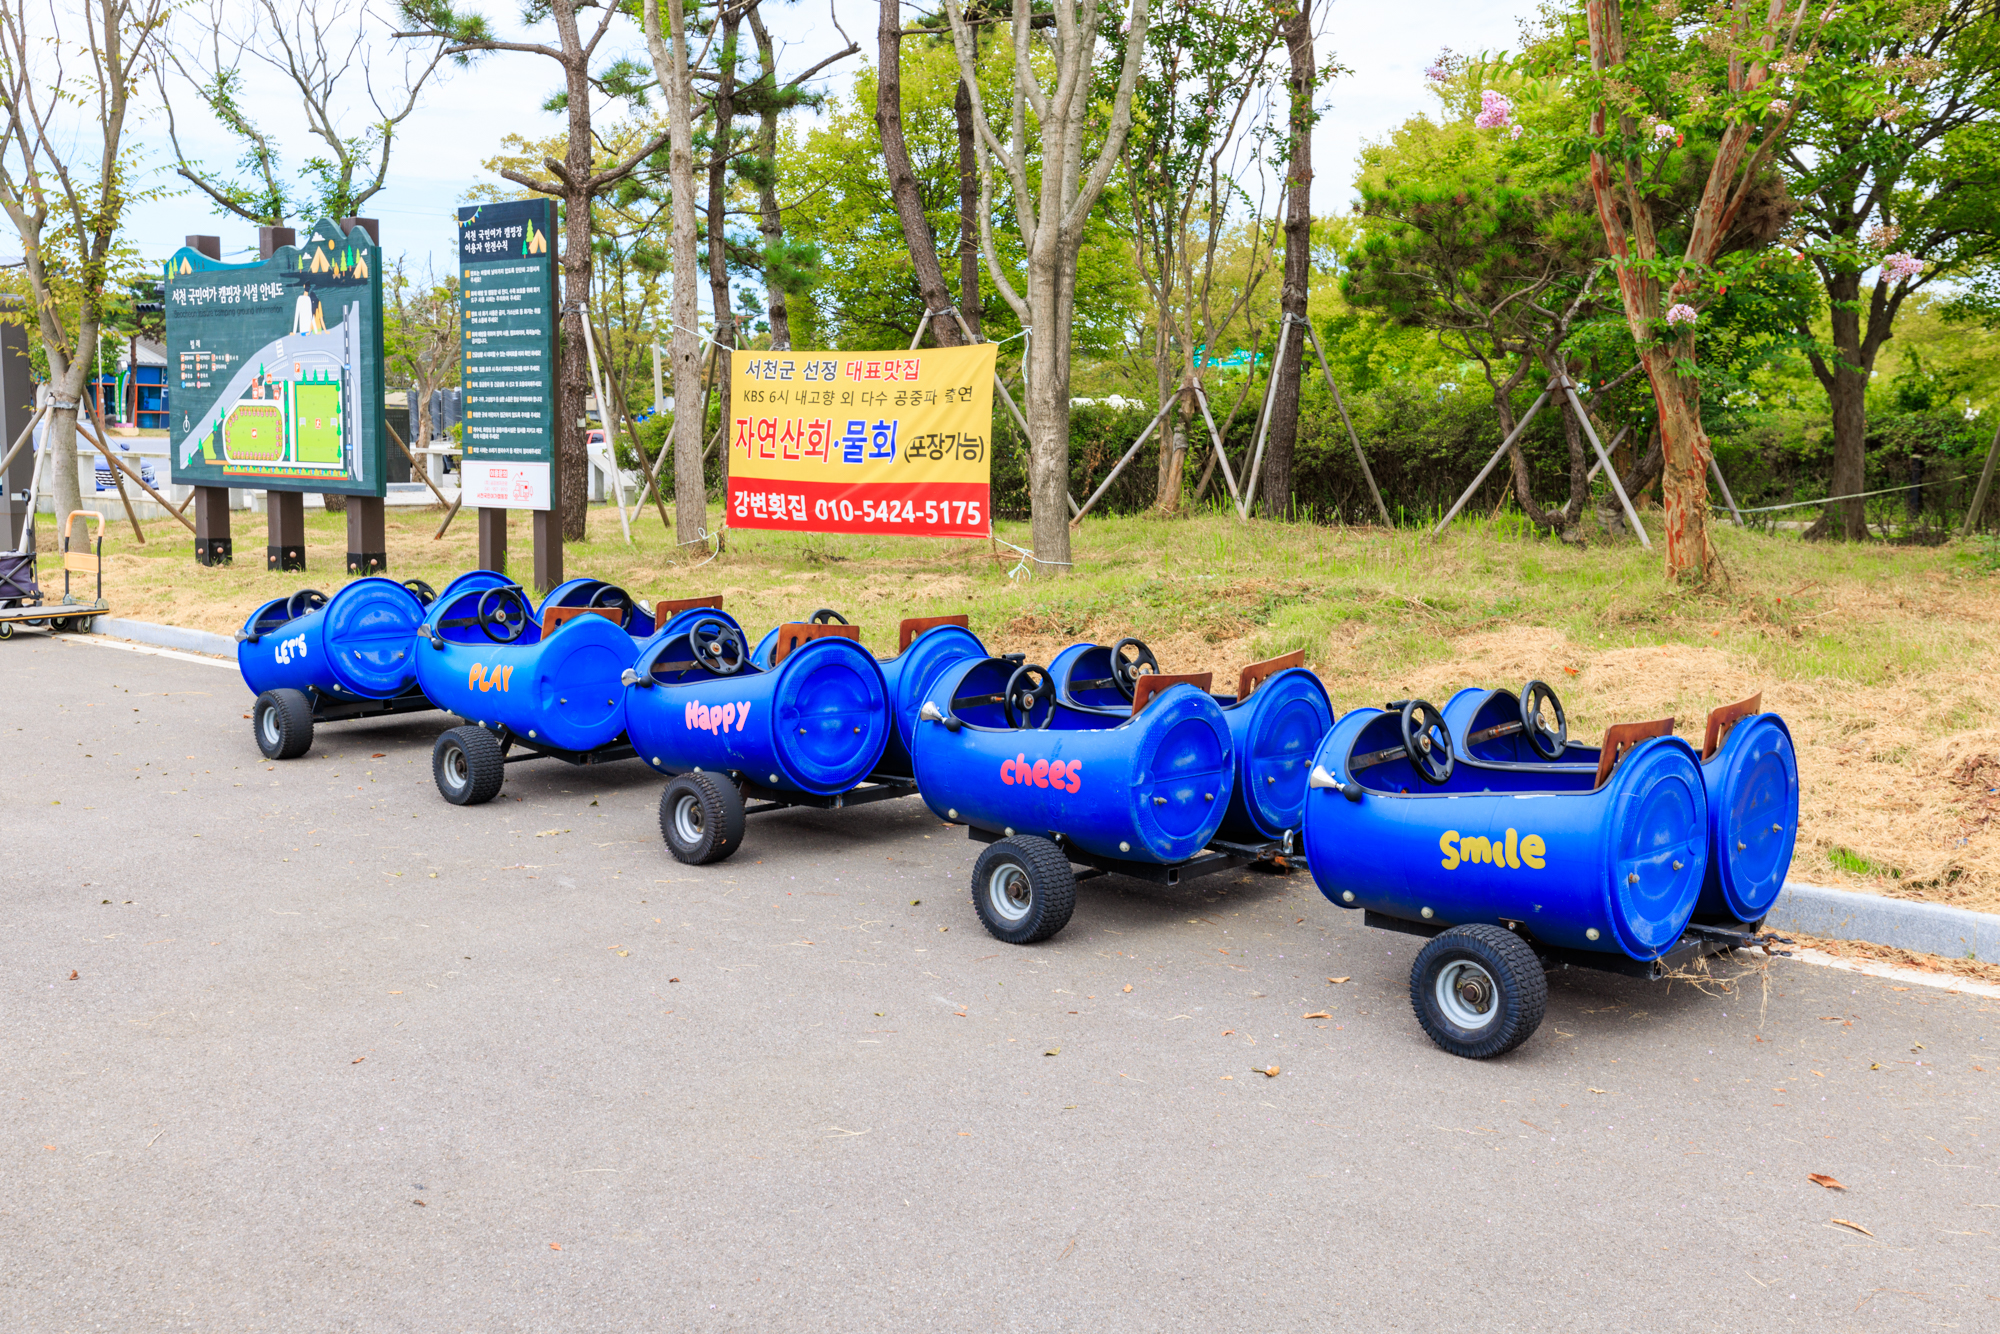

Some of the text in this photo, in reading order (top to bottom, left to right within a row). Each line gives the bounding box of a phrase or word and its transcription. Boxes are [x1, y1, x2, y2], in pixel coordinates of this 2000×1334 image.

[464, 239, 508, 254] 이용자 안전수칙
[503, 225, 523, 238] 캠핑장
[171, 281, 284, 306] 서천 국민여가 캠핑장 시설 안내도
[173, 309, 198, 318] Seocheon
[214, 308, 236, 317] camping
[237, 307, 254, 316] ground
[255, 305, 283, 315] information
[745, 358, 921, 382] 서천군 선정 대표맛집
[743, 385, 973, 407] KBS 6시 내고향 외 다수 공중파 출연
[903, 431, 985, 464] (포장가능)
[733, 489, 982, 526] 강변횟집 010-5424-5175
[274, 633, 308, 665] LET'S
[468, 662, 514, 693] PLAY
[685, 699, 751, 736] Happy
[1000, 752, 1083, 794] chees
[1439, 827, 1547, 871] Smile
